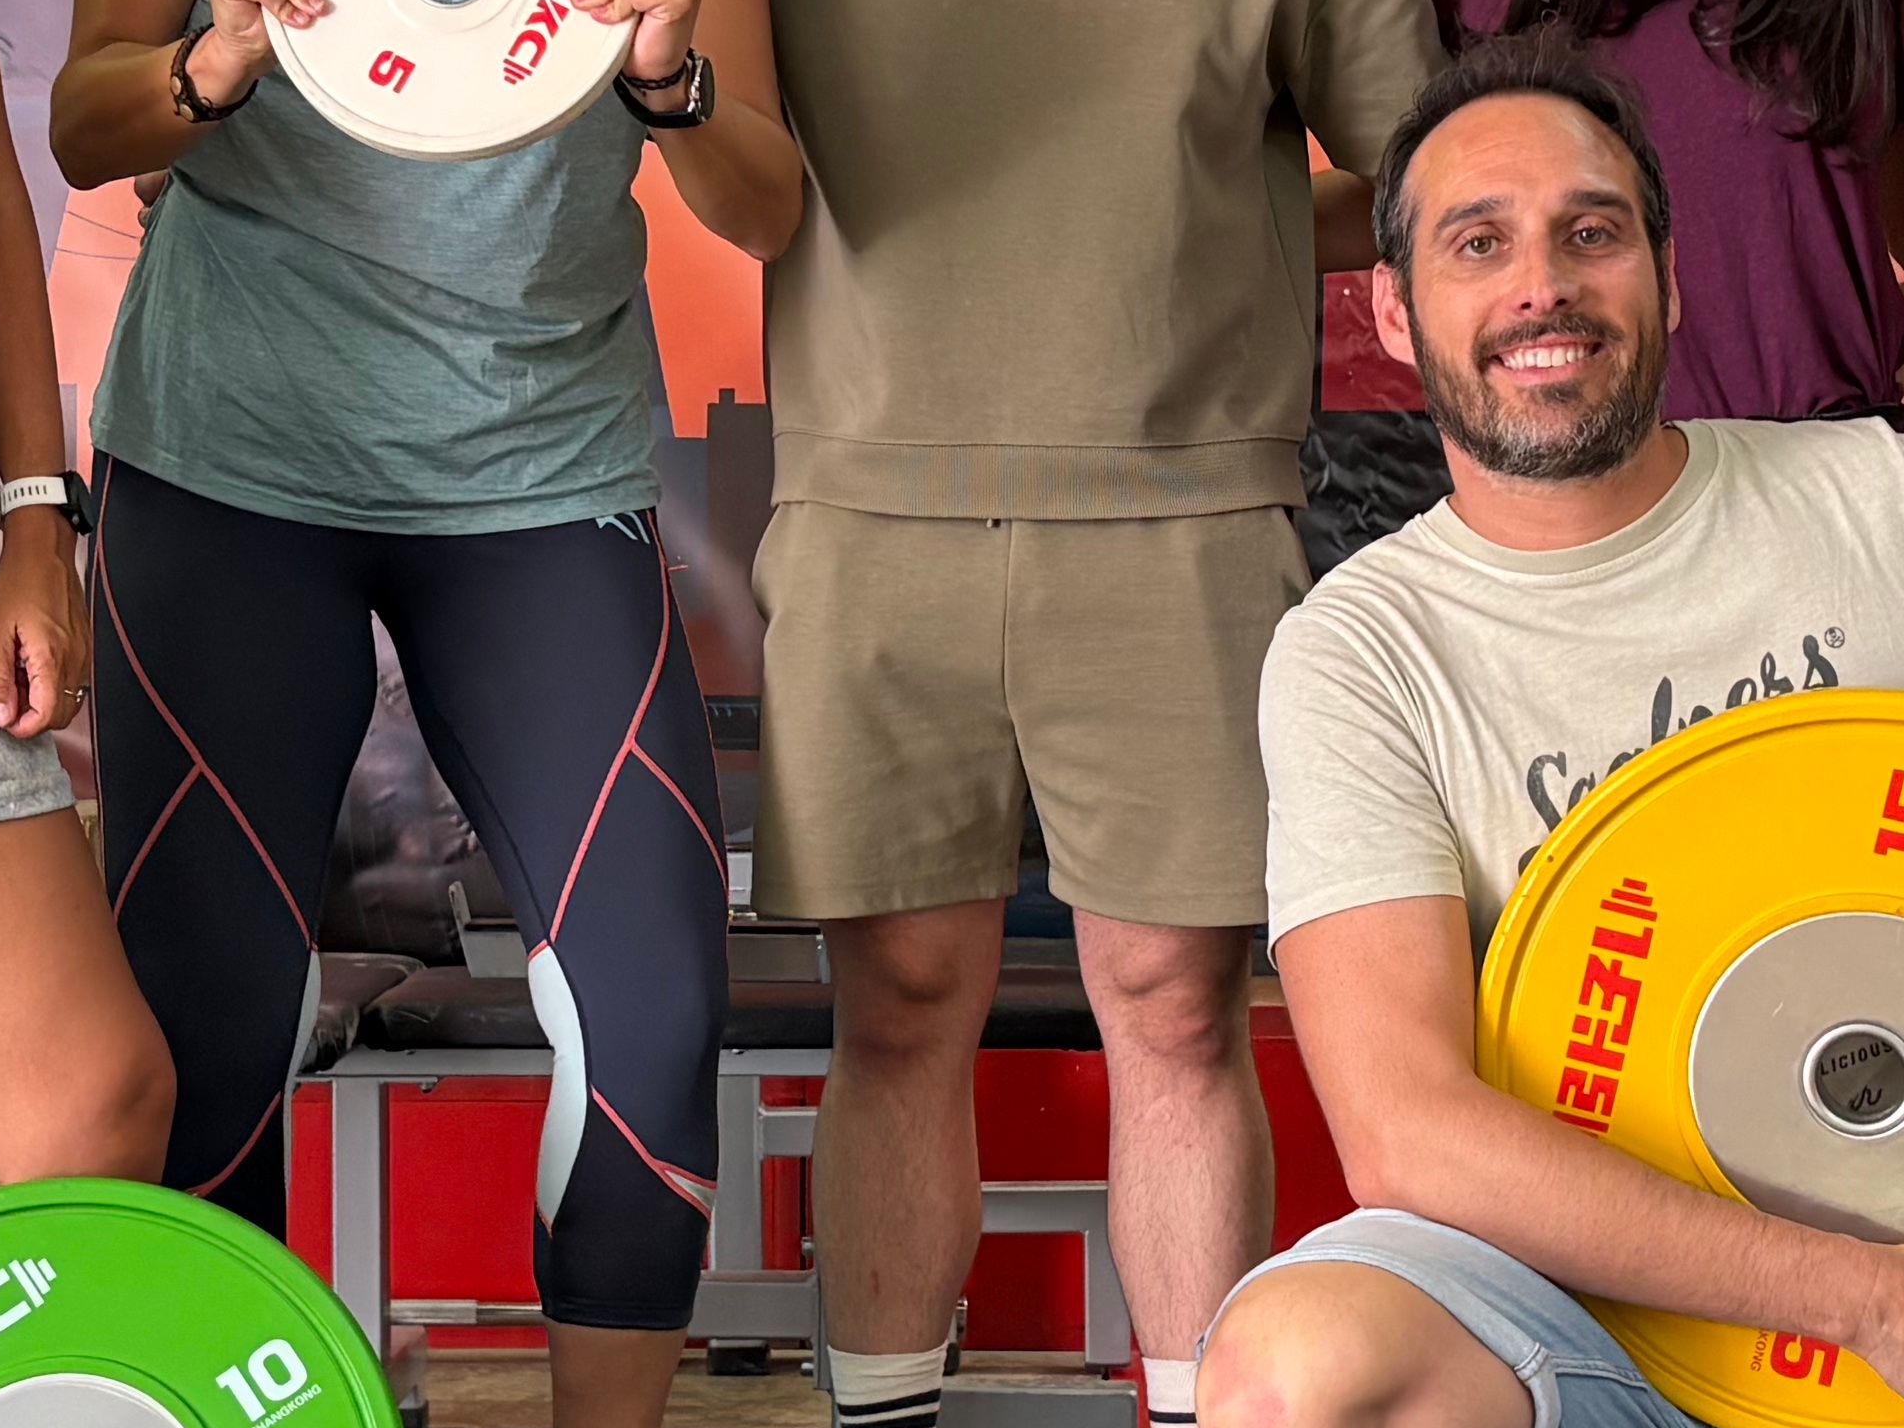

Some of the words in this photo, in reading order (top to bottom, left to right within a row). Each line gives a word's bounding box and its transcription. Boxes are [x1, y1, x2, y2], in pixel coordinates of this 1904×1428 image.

[368, 50, 416, 94] 5
[215, 1338, 309, 1423] 10
[1771, 1330, 1840, 1388] 5
